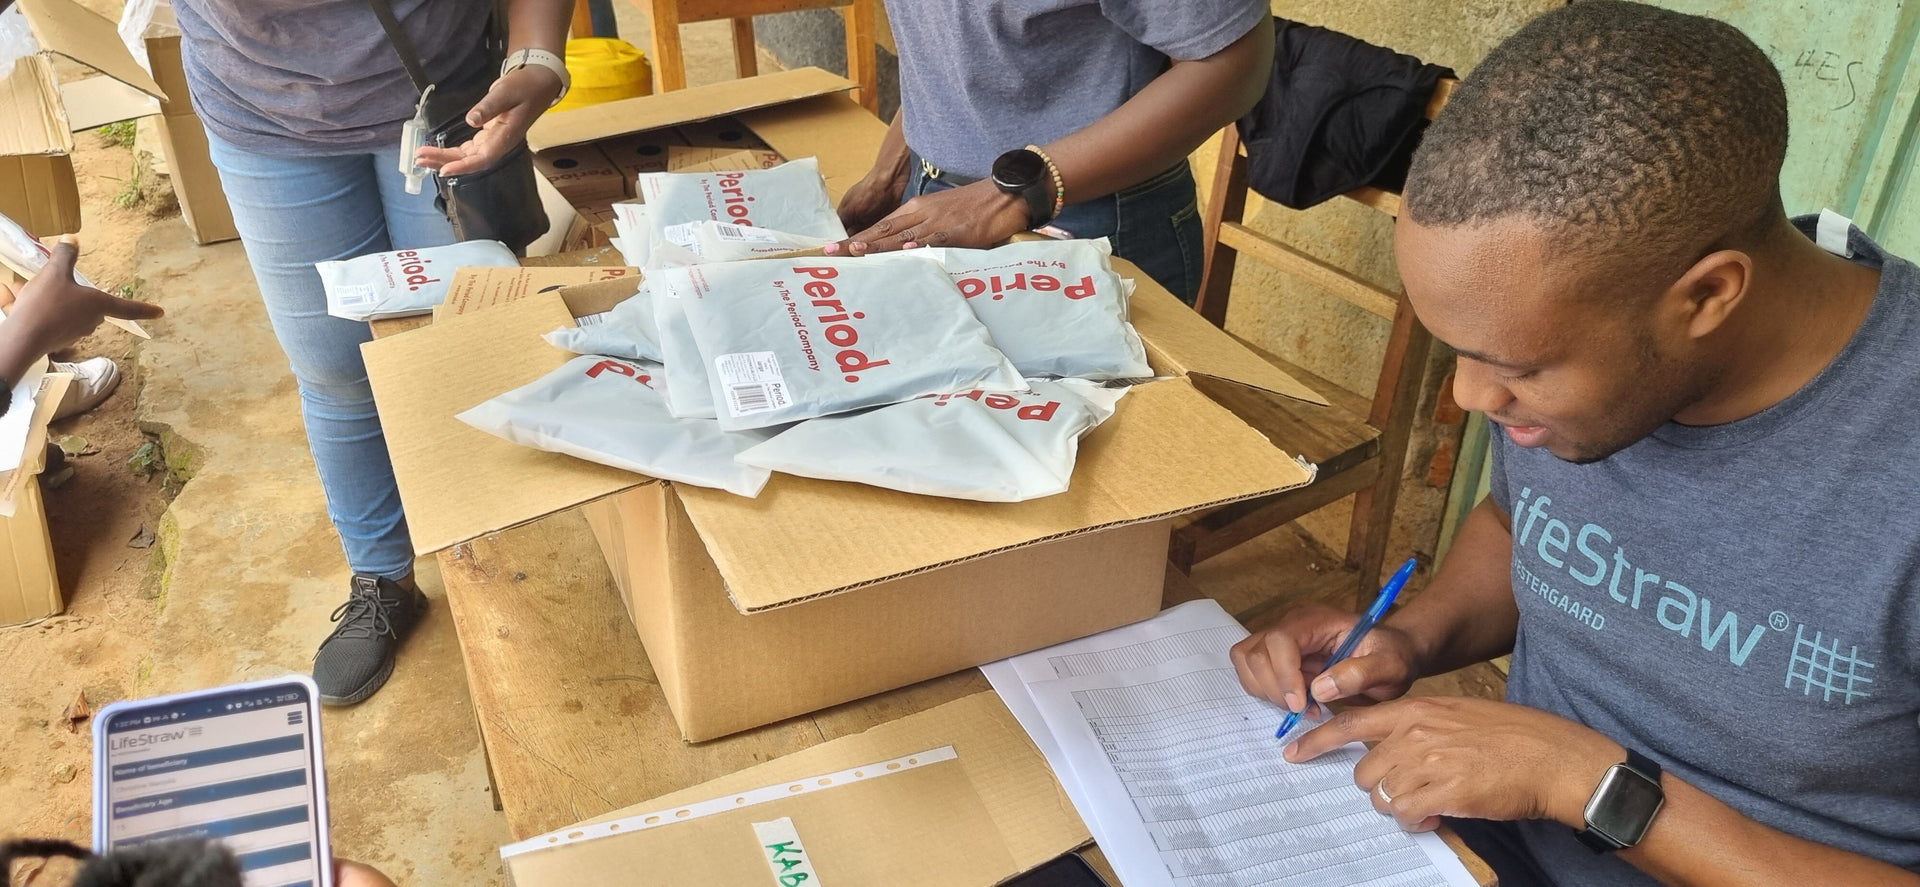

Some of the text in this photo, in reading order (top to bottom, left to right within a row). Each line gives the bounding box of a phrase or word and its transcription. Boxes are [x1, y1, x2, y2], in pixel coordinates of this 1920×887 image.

[397, 250, 441, 291] eriod.
[956, 272, 1097, 301] Perio
[773, 280, 820, 372] By The Period Company
[792, 266, 891, 384] Period.
[913, 389, 1062, 422] Peri
[111, 729, 184, 751] LifeStraw
